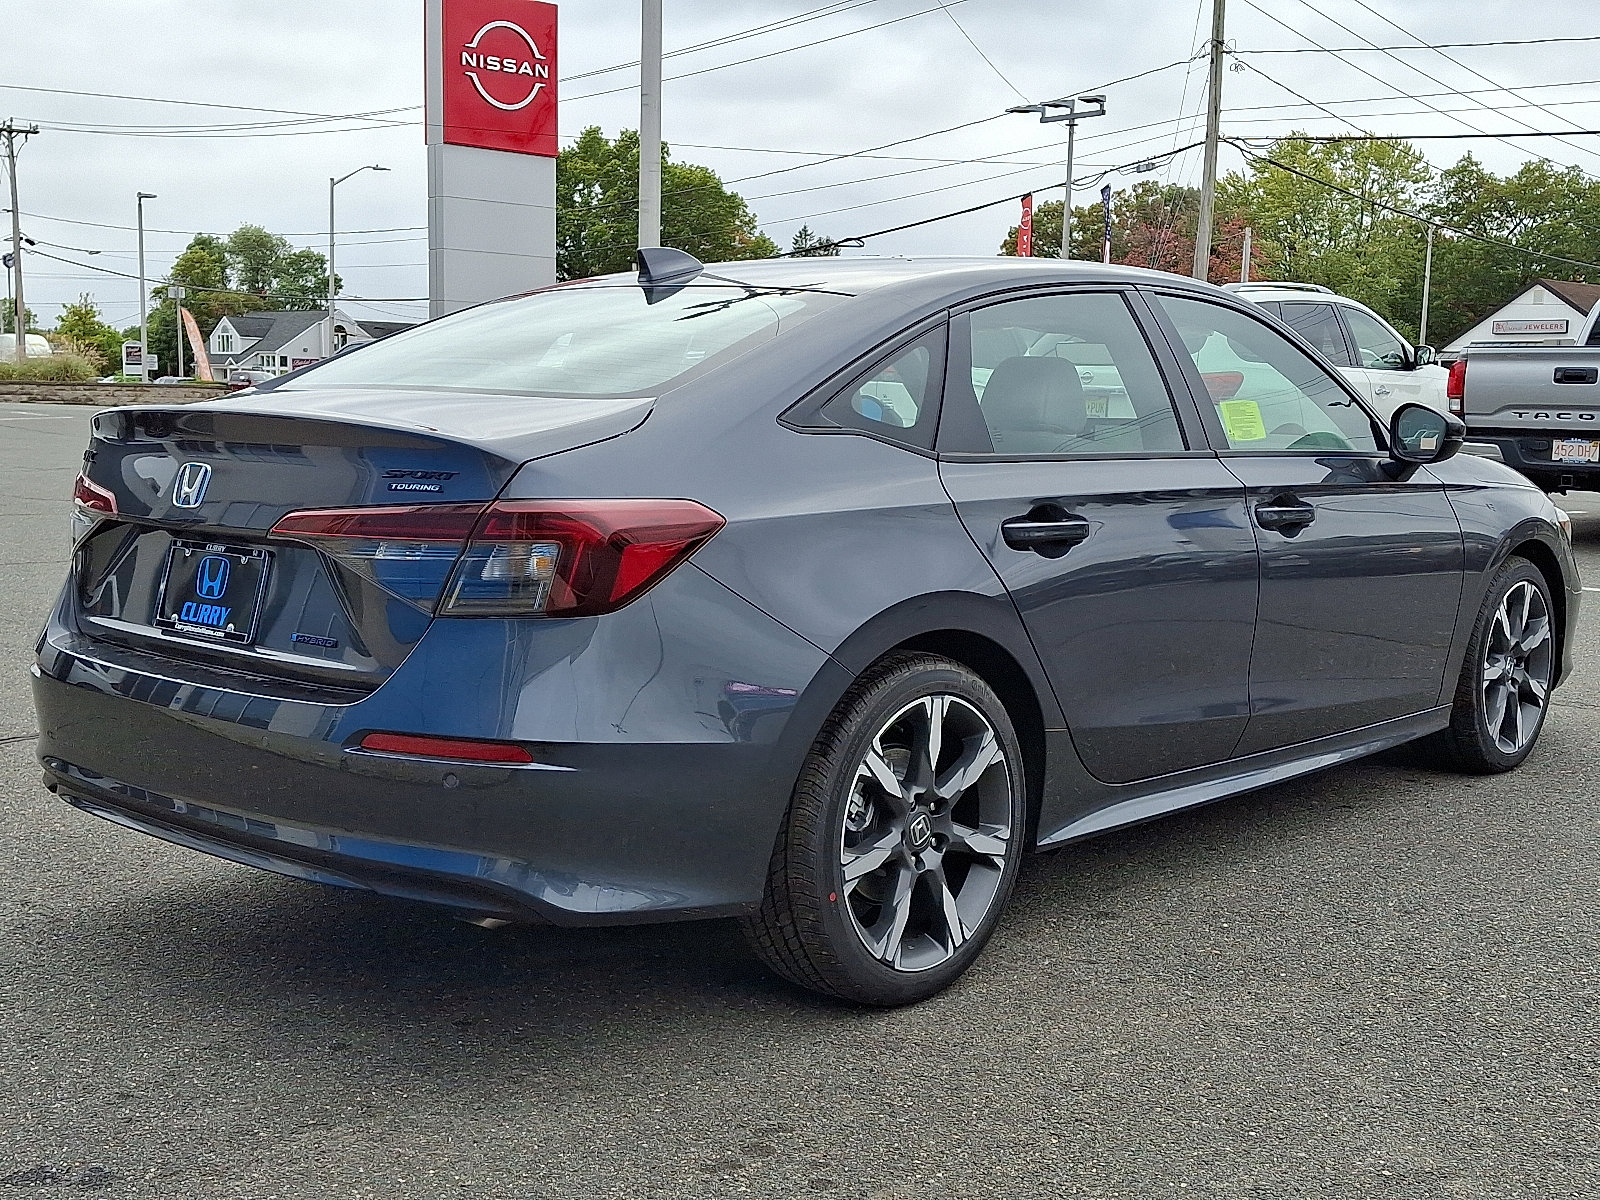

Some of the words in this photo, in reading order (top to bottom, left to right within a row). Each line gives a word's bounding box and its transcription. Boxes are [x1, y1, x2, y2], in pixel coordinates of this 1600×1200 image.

[461, 51, 549, 79] NISSAN
[1511, 411, 1596, 420] TACO
[1554, 445, 1575, 457] 452
[1577, 445, 1598, 458] DH7
[382, 469, 460, 480] SPORT
[390, 483, 440, 491] TOURING
[181, 601, 232, 626] CURRY
[296, 635, 334, 648] HYBRID
